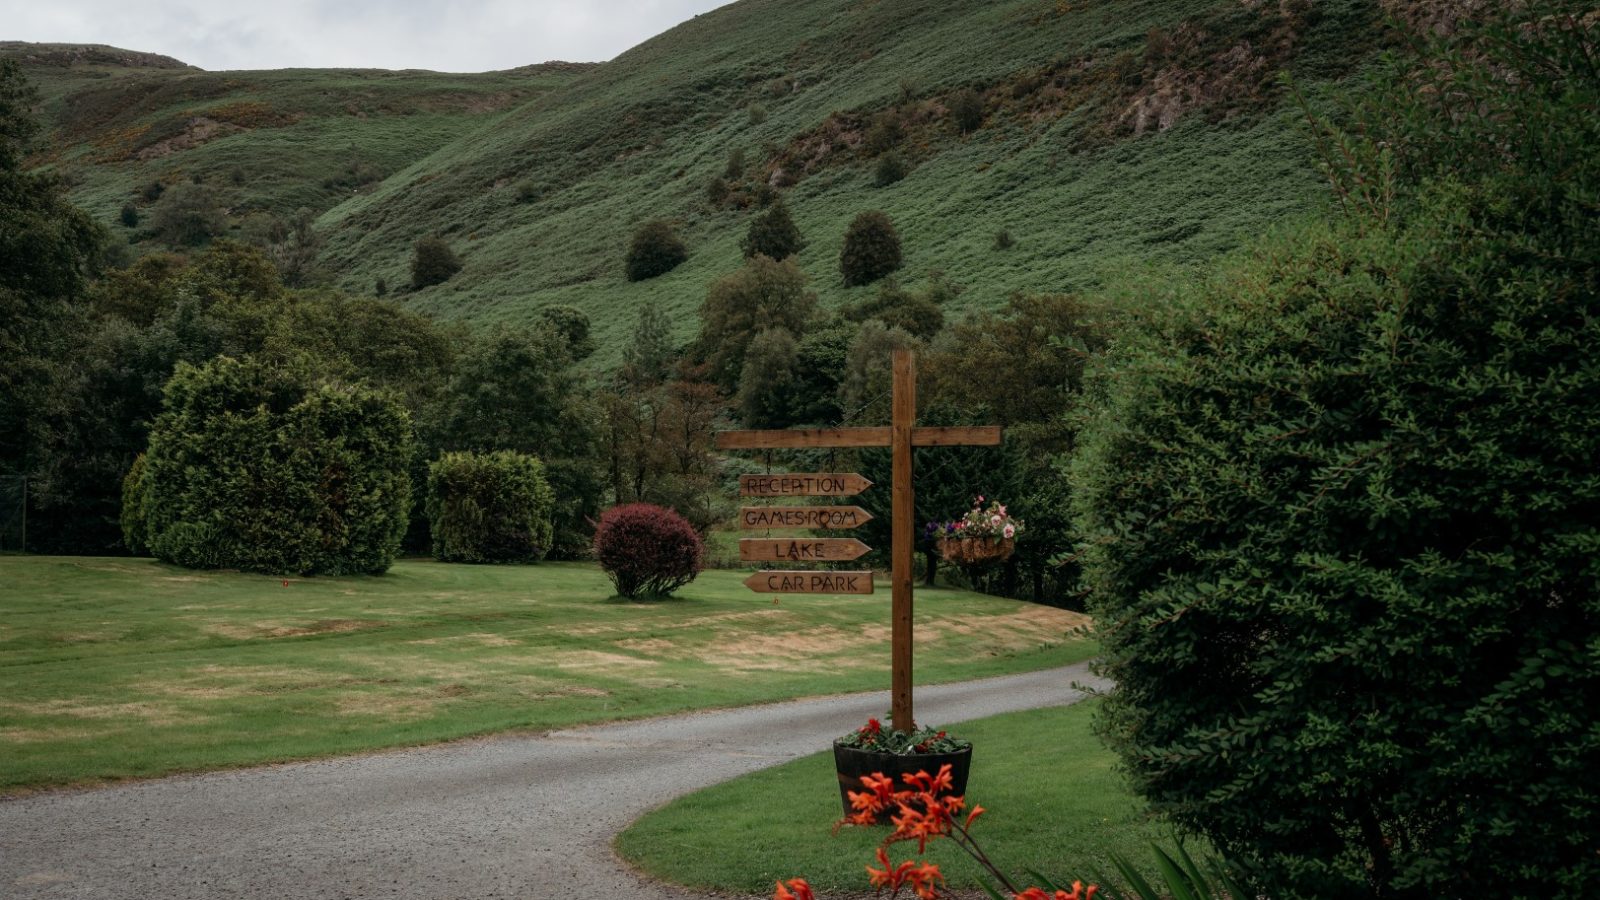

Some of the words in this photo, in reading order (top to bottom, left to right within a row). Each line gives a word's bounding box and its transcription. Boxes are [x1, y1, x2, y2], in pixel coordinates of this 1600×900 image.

[747, 478, 845, 493] RECEPTION
[775, 543, 825, 558] LAKE
[767, 575, 804, 591] CAR
[811, 575, 858, 591] PARK
